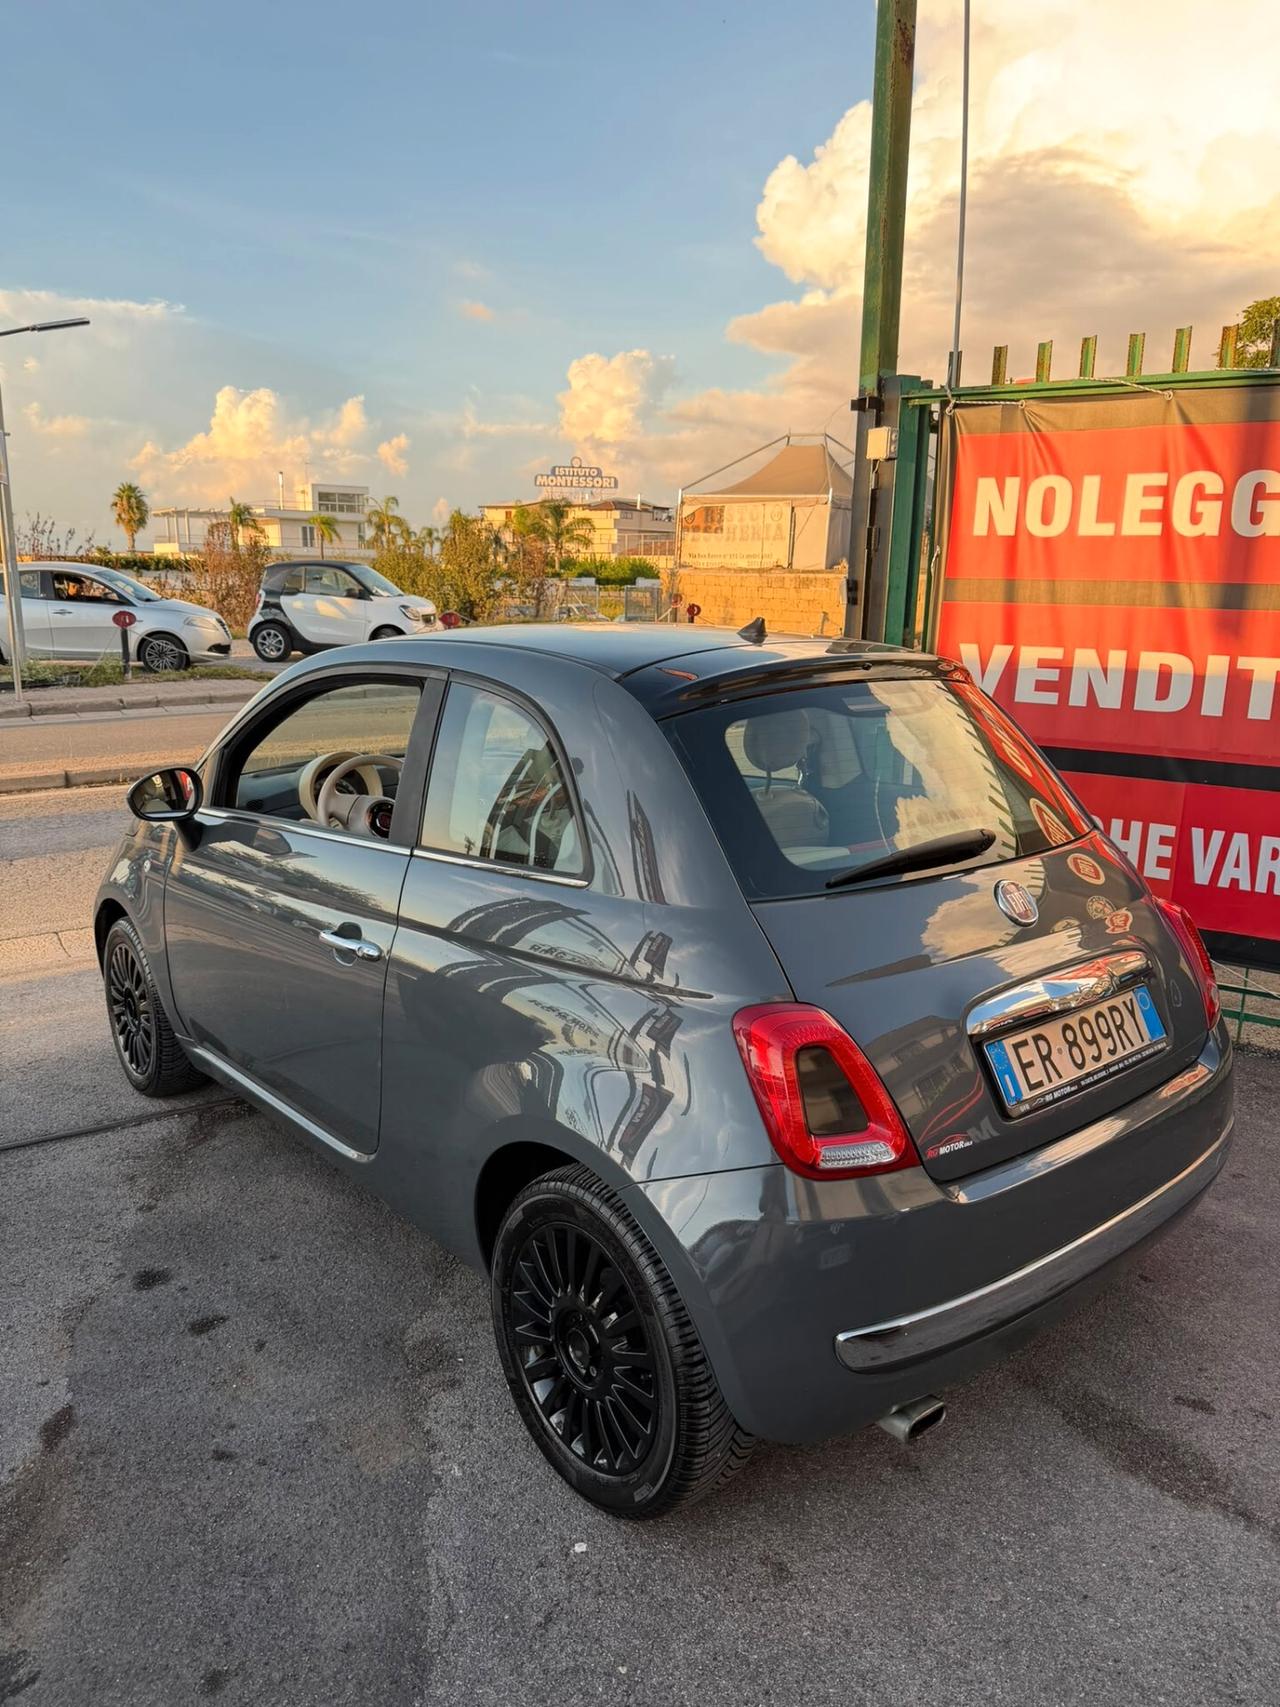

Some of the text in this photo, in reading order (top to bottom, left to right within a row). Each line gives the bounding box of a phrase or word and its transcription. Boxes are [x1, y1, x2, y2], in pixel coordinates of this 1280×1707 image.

[536, 475, 615, 488] MONTESSORI
[555, 467, 598, 476] ISTITUTO
[973, 470, 1280, 537] NOLEGG
[959, 643, 1280, 720] VENDIT
[1191, 826, 1280, 897] VAR
[1006, 890, 1032, 914] FIAT
[1012, 1033, 1063, 1091] ER
[1061, 997, 1145, 1070] 899RY
[939, 1140, 964, 1155] MOTOR
